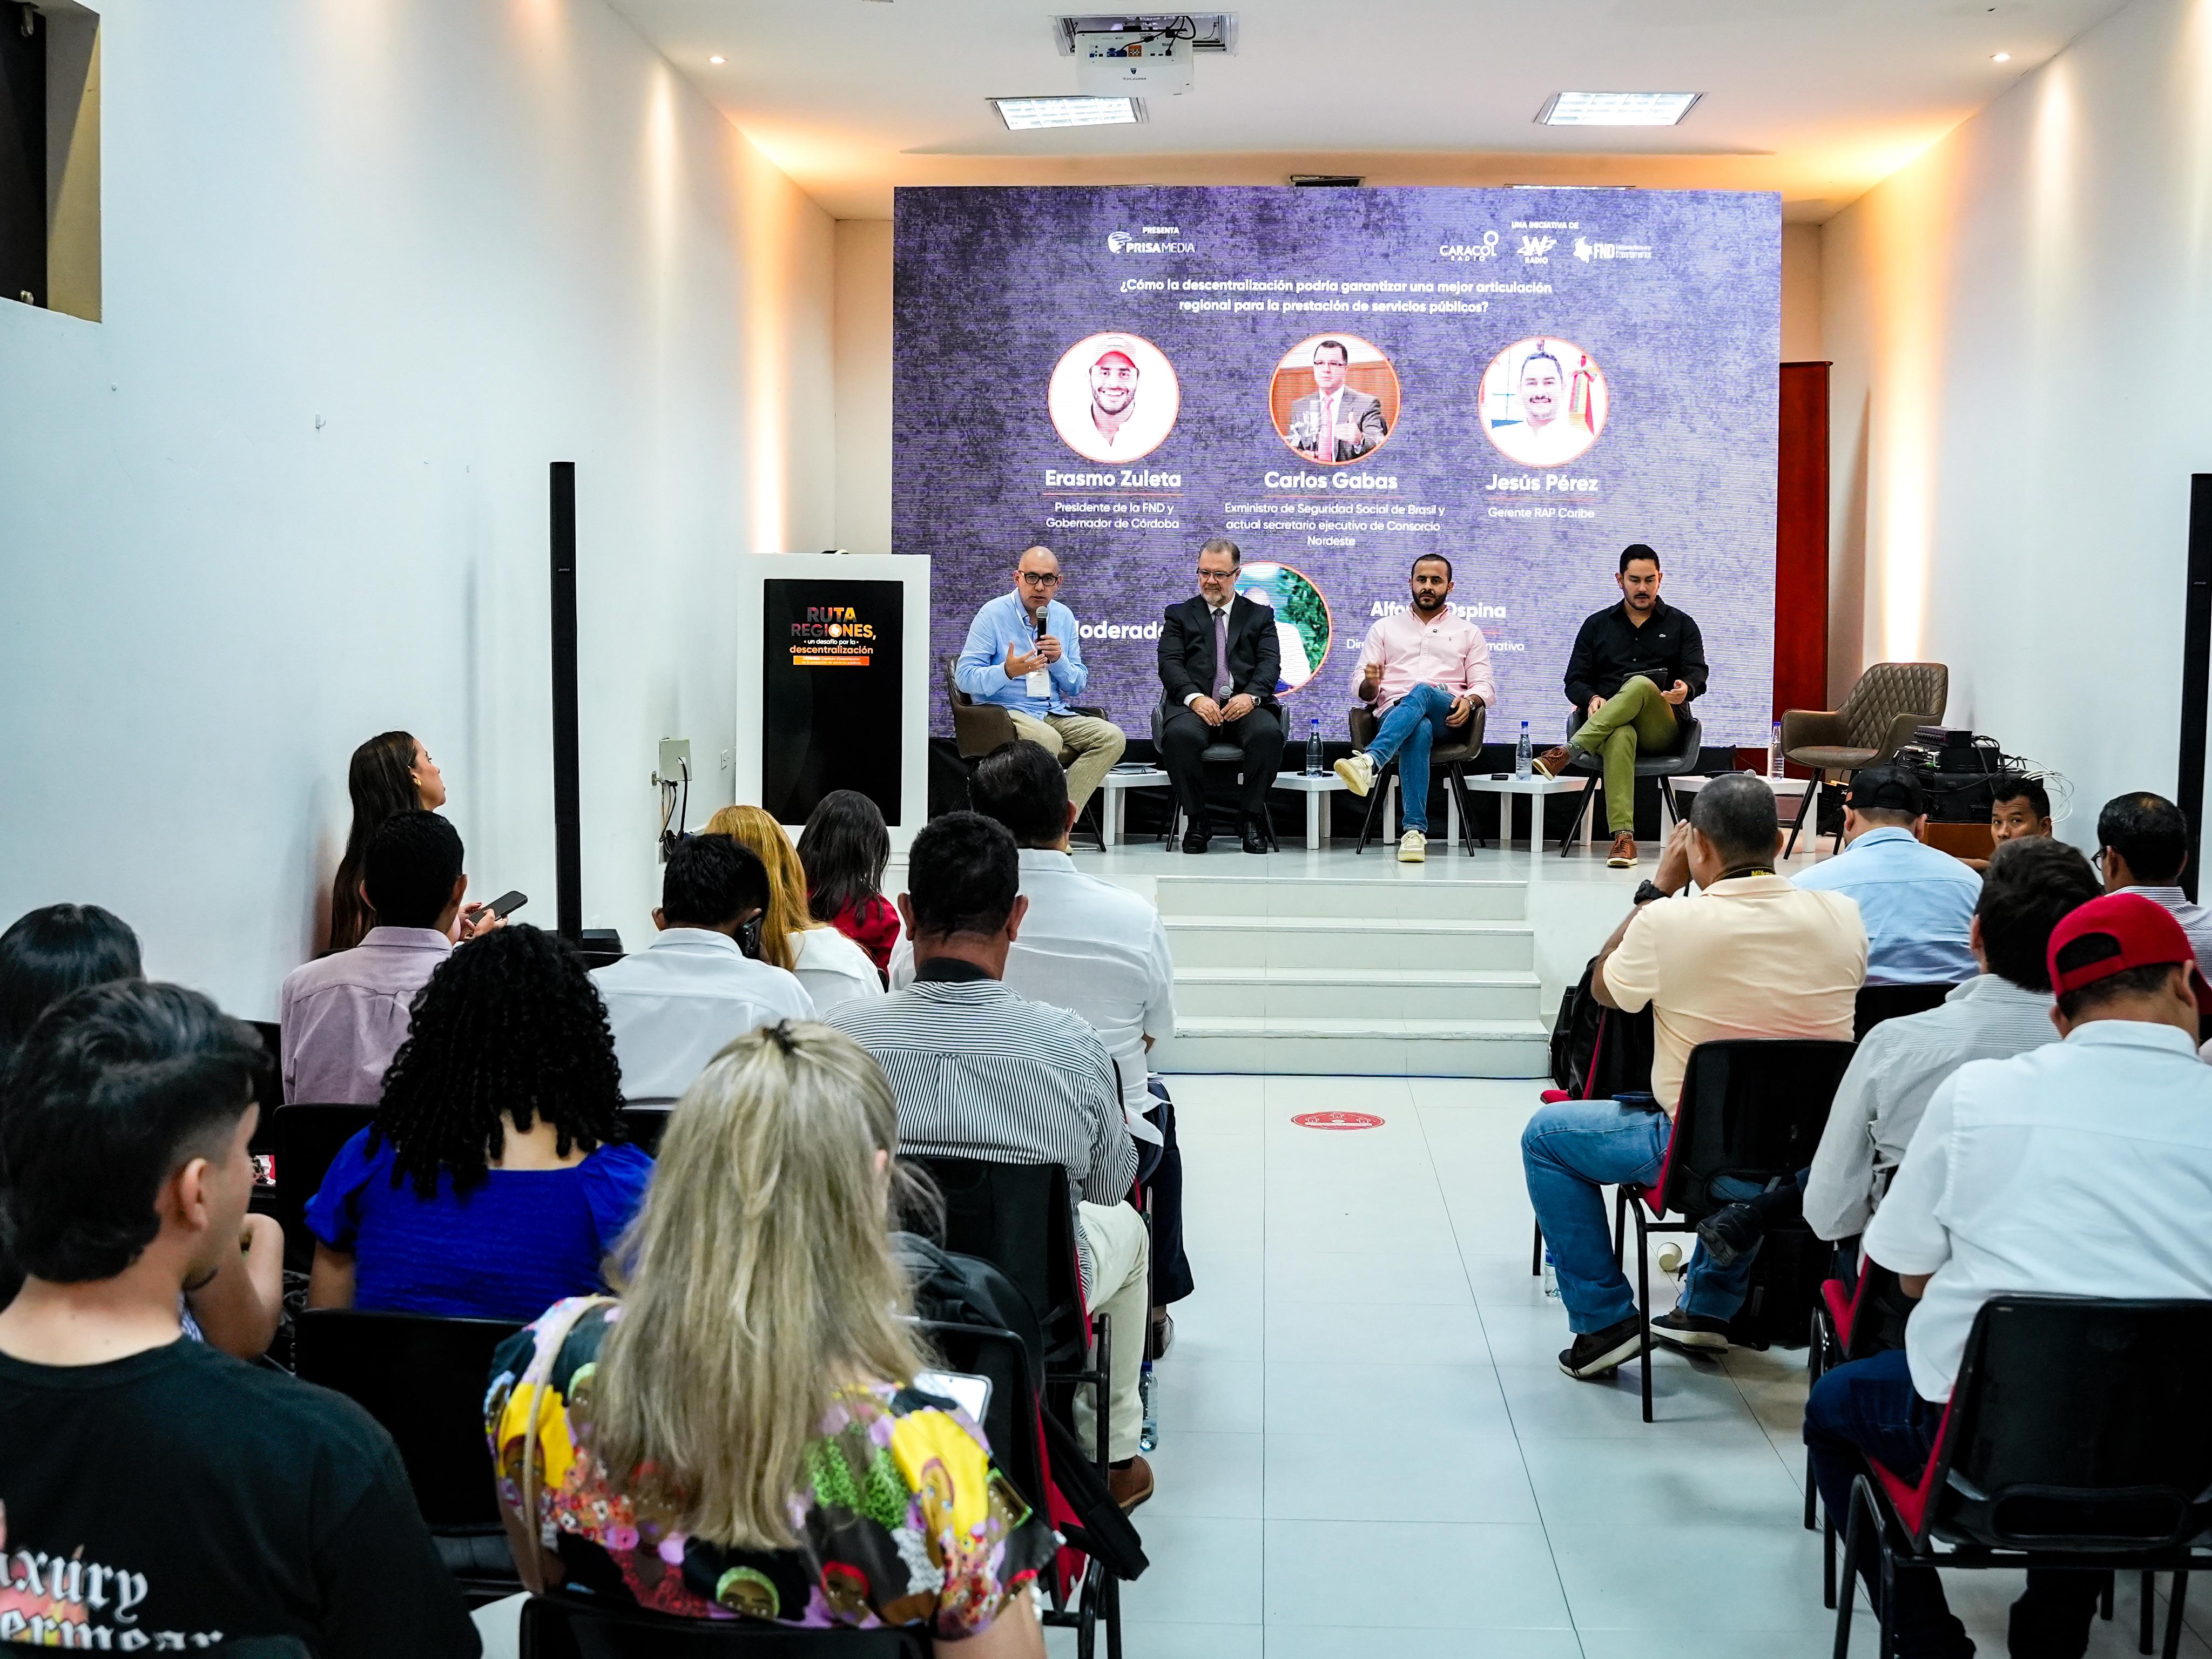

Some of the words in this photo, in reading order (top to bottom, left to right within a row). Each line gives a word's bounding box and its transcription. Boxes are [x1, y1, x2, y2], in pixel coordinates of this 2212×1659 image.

[1529, 221, 1568, 229] INICIATIVA
[1568, 221, 1579, 230] DE
[1439, 230, 1499, 257] CARACOL
[1594, 243, 1616, 259] FND
[1120, 279, 1164, 293] ¿Cómo
[1167, 278, 1179, 290] la
[1182, 279, 1293, 291] descentralización
[1341, 280, 1407, 294] garantizar
[1410, 282, 1434, 292] una
[1438, 281, 1474, 294] mejor
[1476, 282, 1552, 293] articulación
[1179, 299, 1231, 313] regional
[1234, 301, 1264, 313] para
[1267, 300, 1279, 311] la
[1283, 300, 1350, 314] prestación
[1352, 300, 1369, 311] de
[1372, 301, 1426, 312] servicios
[1429, 301, 1489, 315] públicos?
[1045, 469, 1116, 487] Erasmo
[1120, 469, 1182, 487] Zuleta
[1264, 471, 1328, 489] Carlos
[1332, 473, 1399, 489] Gabas
[1486, 473, 1540, 491] Jesús
[1546, 474, 1599, 491] Pérez
[1055, 502, 1110, 513] Presidente
[1112, 502, 1128, 513] de
[1130, 503, 1140, 513] la
[1142, 503, 1165, 513] FND
[1167, 504, 1174, 516] y
[1225, 503, 1278, 514] Exministro
[1280, 503, 1295, 514] de
[1297, 503, 1354, 516] Seguridad
[1355, 504, 1389, 515] Social
[1390, 504, 1406, 515] de
[1407, 504, 1437, 515] Brasil
[1438, 507, 1446, 517] y
[1488, 507, 1532, 518] Gerente
[1534, 508, 1556, 518] RAP
[1558, 508, 1595, 518] Caribe
[1046, 517, 1111, 529] Gobernador
[1114, 518, 1129, 529] de
[1130, 517, 1180, 529] Córdoba
[1225, 520, 1261, 530] actual
[1263, 520, 1317, 531] secretario
[1318, 520, 1367, 533] ejecutivo
[1369, 521, 1385, 531] de
[1386, 520, 1441, 532] Consorcio
[1307, 535, 1355, 546] Nordeste
[807, 606, 858, 623] RUTA
[1370, 601, 1410, 616] Alfo
[791, 623, 876, 640] REGIONES,
[790, 645, 873, 654] descentralización
[1486, 641, 1525, 651] mativo
